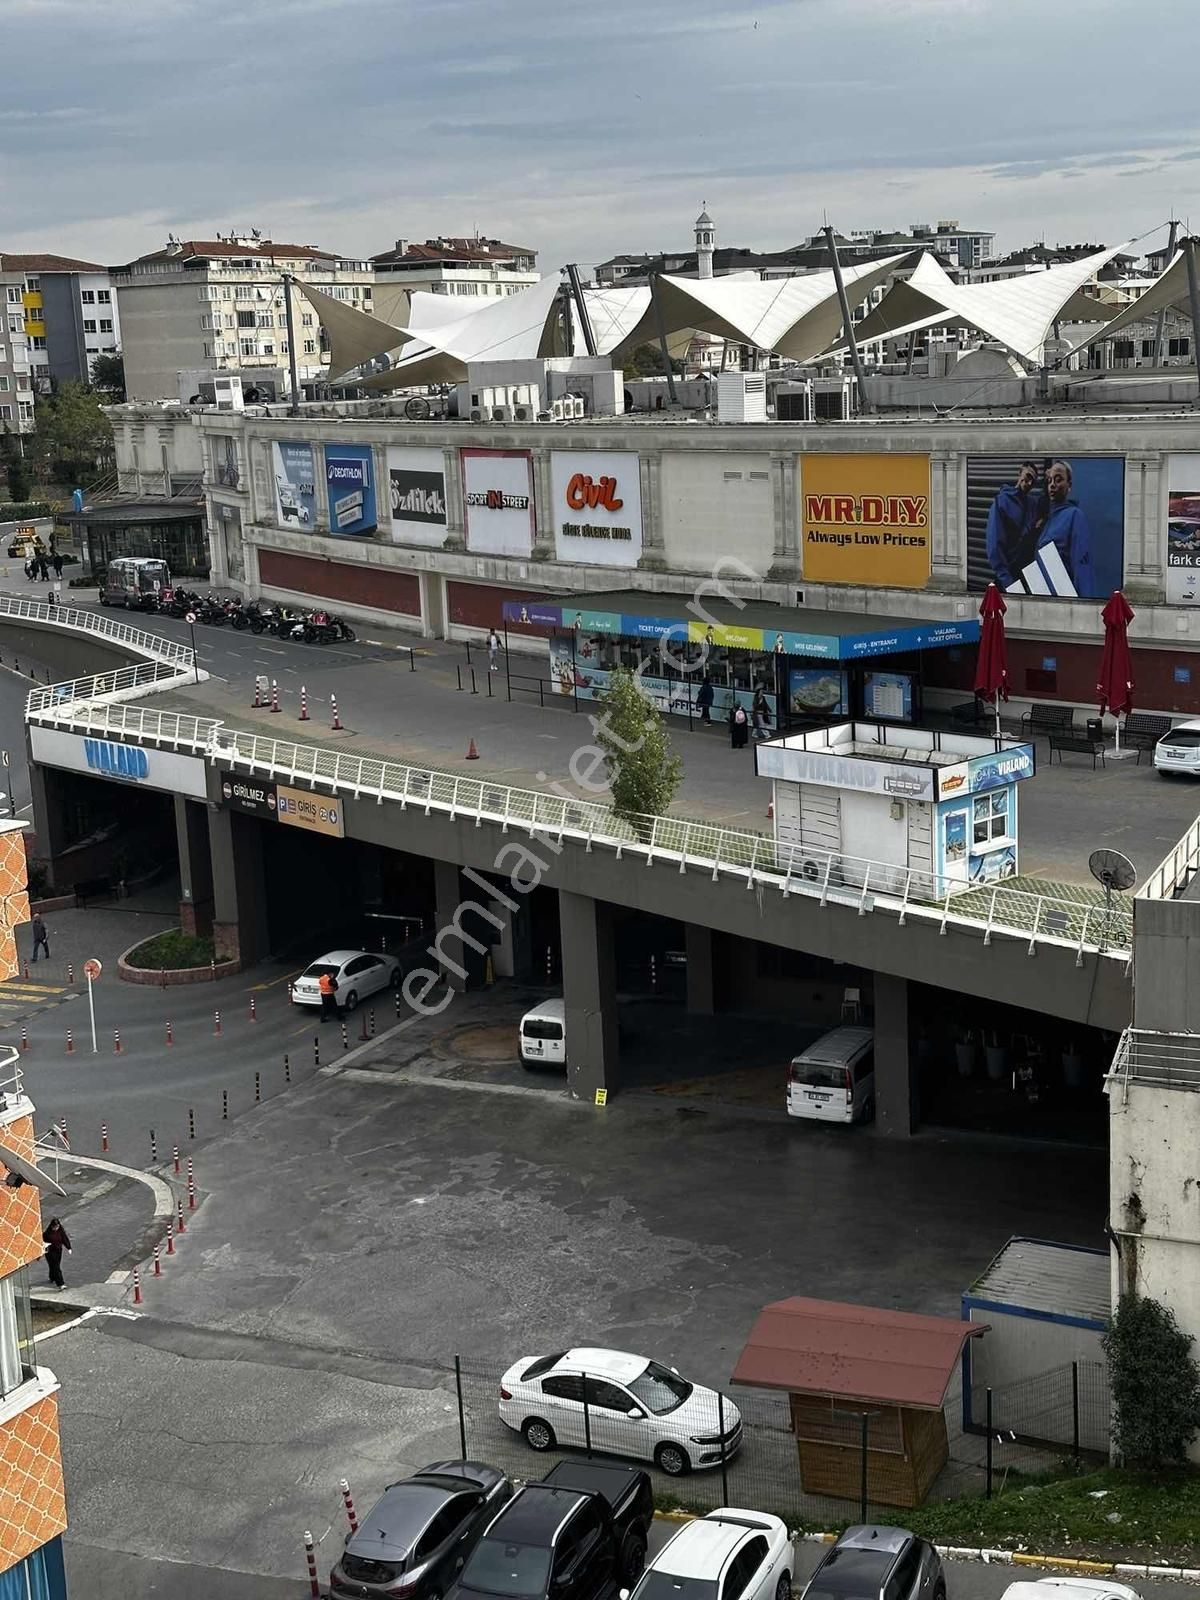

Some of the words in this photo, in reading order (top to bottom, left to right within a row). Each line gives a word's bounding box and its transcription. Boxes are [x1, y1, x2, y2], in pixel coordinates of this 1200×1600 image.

[334, 466, 362, 480] DECATHLON
[390, 479, 446, 515] Özdilek
[467, 493, 487, 505] SPORT
[487, 490, 502, 509] IN
[502, 495, 528, 508] STREET
[807, 530, 852, 546] Always
[854, 532, 881, 544] Low
[883, 533, 926, 547] Prices
[1169, 553, 1192, 566] fark
[870, 638, 898, 648] ENTRANCE
[928, 635, 944, 643] TICKET
[944, 633, 963, 641] OFFICE
[84, 738, 149, 779] VIALAND
[998, 755, 1030, 776] VIALAND
[233, 783, 265, 802] GİRİLMEZ
[297, 799, 317, 817] GİRİŞ
